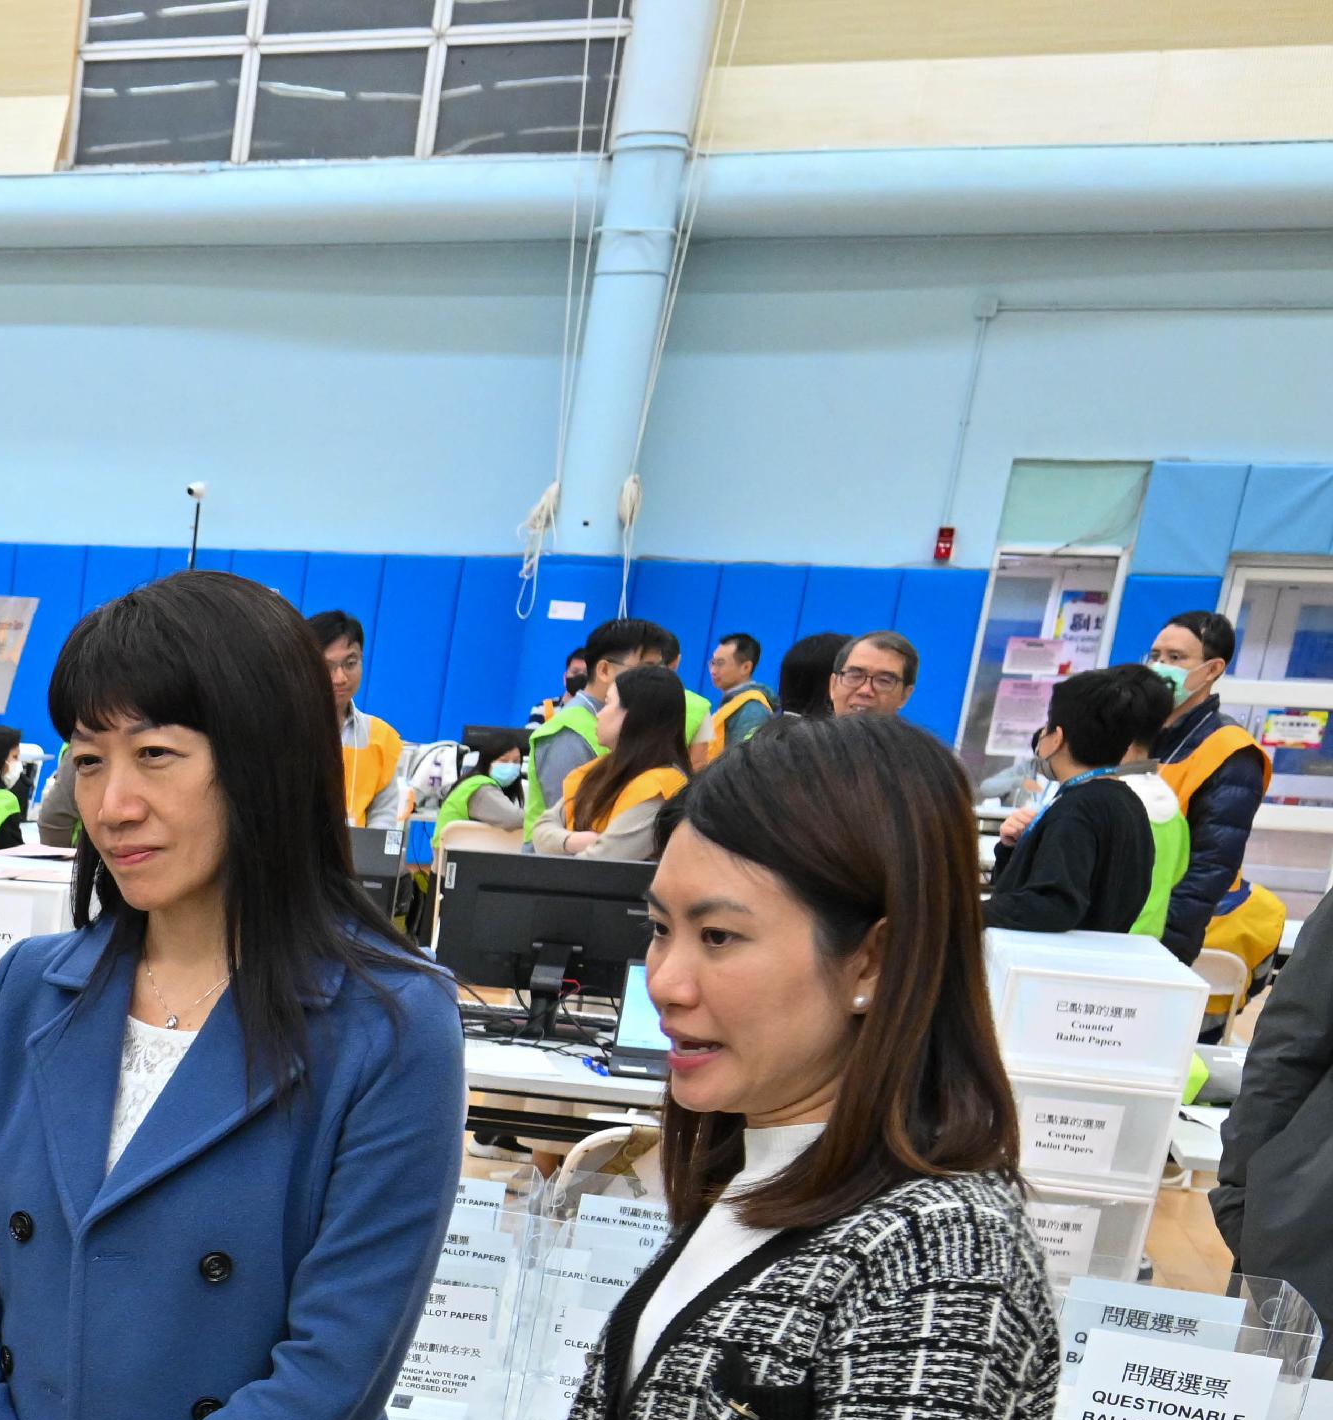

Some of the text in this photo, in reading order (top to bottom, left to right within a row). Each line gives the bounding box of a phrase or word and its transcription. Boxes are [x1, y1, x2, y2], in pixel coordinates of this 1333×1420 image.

[1071, 1020, 1114, 1032] Counted
[1056, 1032, 1122, 1047] Ballot Papers
[1048, 1130, 1086, 1141] Counted
[1035, 1140, 1093, 1155] Ballot Papers
[620, 1206, 668, 1221] 明顯無效
[580, 1214, 617, 1225] CLEARLY
[619, 1220, 651, 1230] INVALID
[639, 1237, 655, 1248] (b)
[442, 1247, 506, 1263] ALLOT PAPERS
[590, 1276, 630, 1287] CLEARLY
[424, 1308, 488, 1321] LLOT PAPERS
[1100, 1305, 1201, 1337] 問題選票
[433, 1370, 452, 1379] VOTE
[1121, 1362, 1232, 1400] 問題選票
[402, 1375, 422, 1383] NAME
[442, 1380, 467, 1388] OTHER
[406, 1382, 441, 1392] CROSSED
[442, 1386, 458, 1394] OUT
